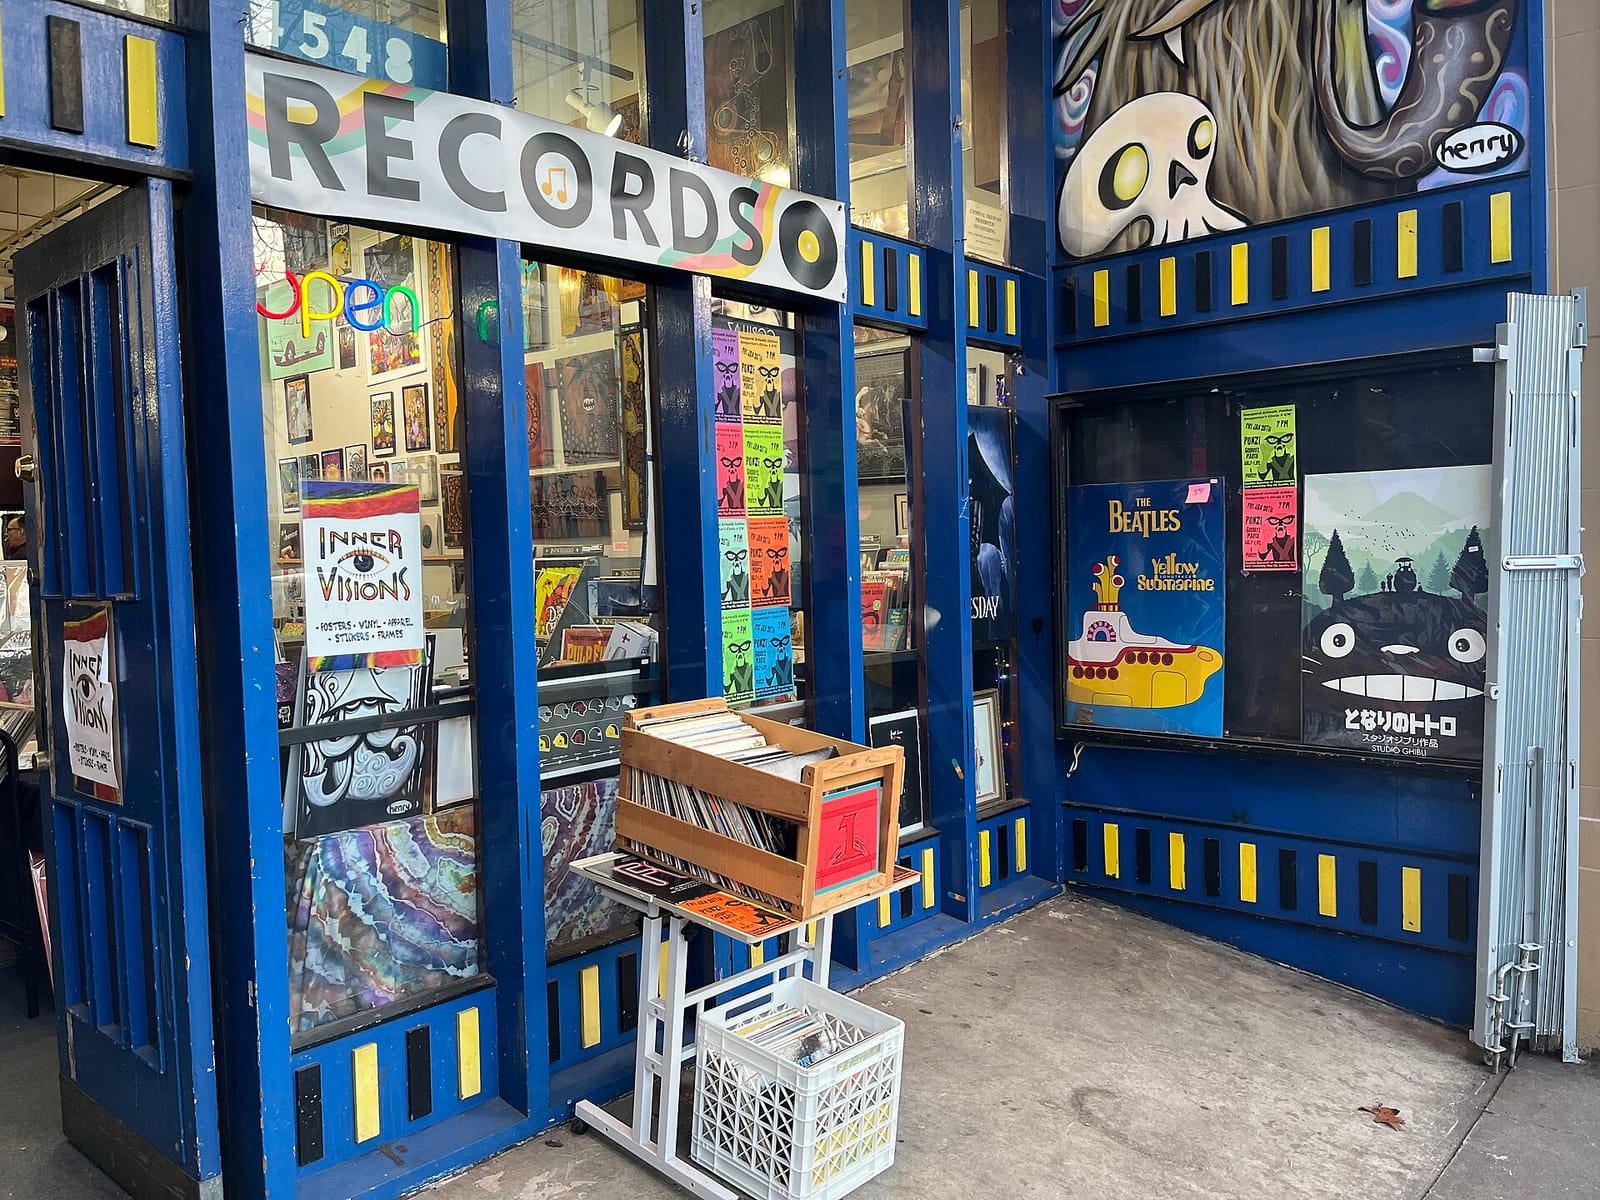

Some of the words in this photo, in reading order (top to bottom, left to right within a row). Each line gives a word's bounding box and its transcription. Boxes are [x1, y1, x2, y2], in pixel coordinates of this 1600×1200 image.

[1440, 133, 1513, 163] henry
[263, 71, 764, 267] RECORDS
[1135, 497, 1152, 507] THE
[1108, 499, 1181, 538] BEATLES
[319, 526, 403, 560] INNER
[1151, 552, 1200, 576] Yellow
[316, 566, 411, 602] VISIONS
[1137, 574, 1215, 591] Submarine
[970, 595, 1000, 620] SDAY
[320, 620, 352, 632] POSTERS
[358, 619, 381, 630] VINYL
[388, 617, 414, 627] APPAREL
[335, 632, 370, 643] STICKERS
[377, 630, 404, 640] FRAMES
[1344, 708, 1457, 737] となりのトトロ
[1362, 733, 1439, 748] スタジオジブリ作品
[1371, 744, 1400, 754] STUDIO
[1401, 747, 1427, 757] GHIBLI
[390, 801, 410, 814] henry
